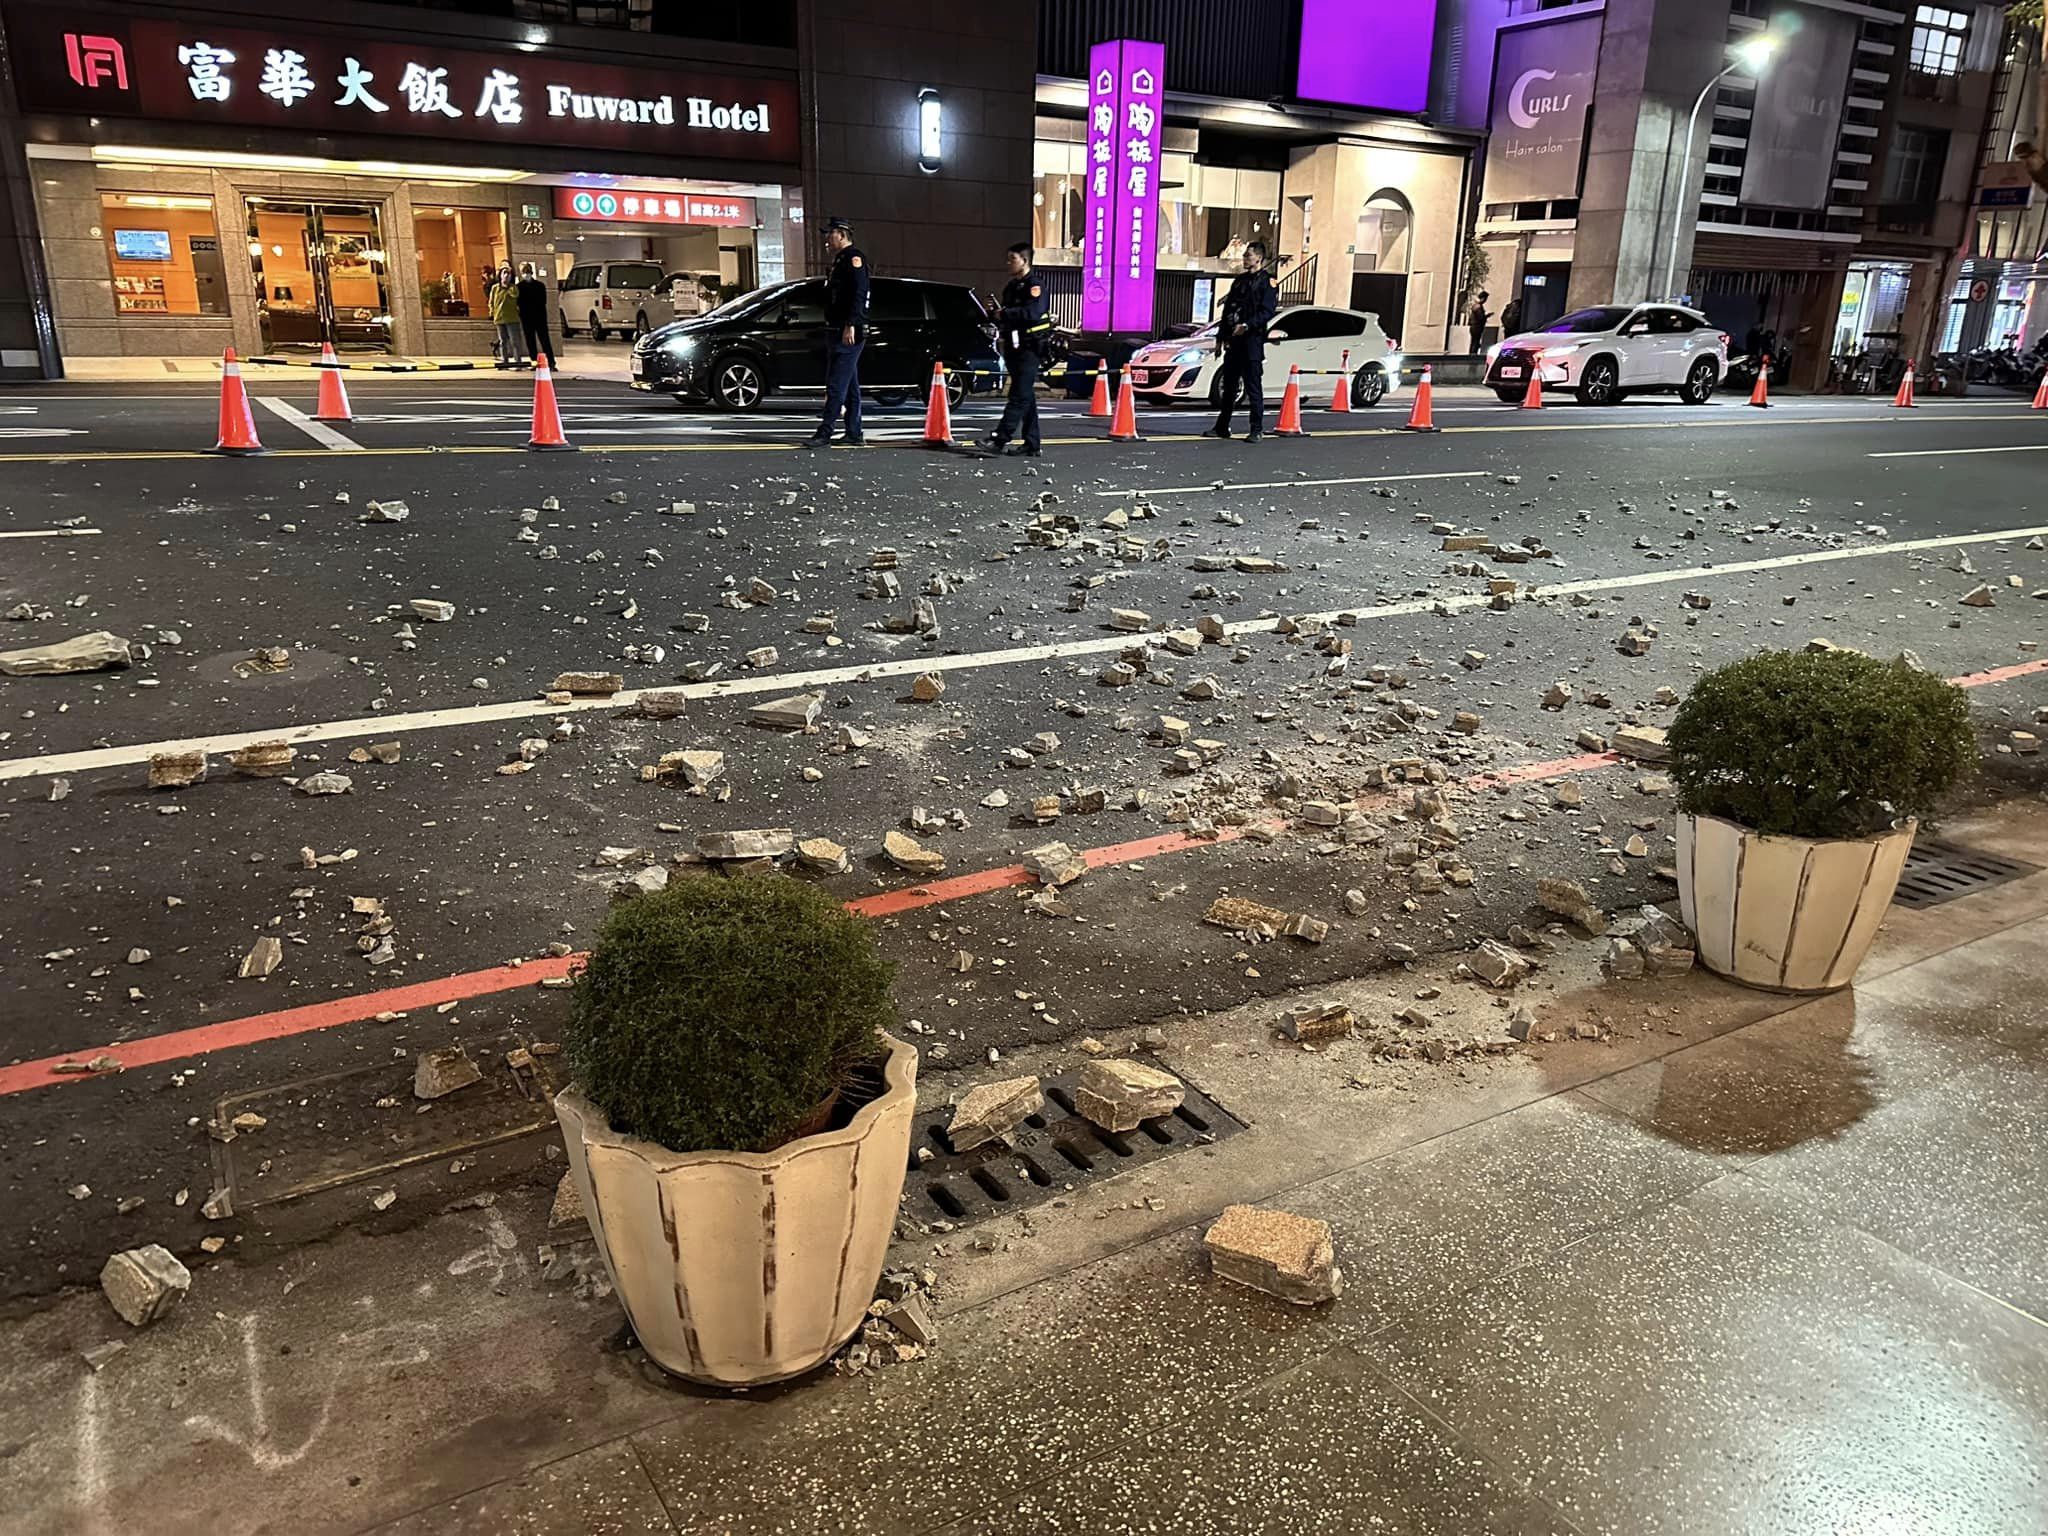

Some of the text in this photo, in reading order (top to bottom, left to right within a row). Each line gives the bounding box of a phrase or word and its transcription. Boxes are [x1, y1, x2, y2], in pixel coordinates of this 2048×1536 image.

[178, 42, 770, 133] 富華大飯店 Fuward Hotel
[1508, 68, 1572, 129] CURLS
[1505, 135, 1564, 159] Hair salon
[623, 197, 681, 218] 停車場
